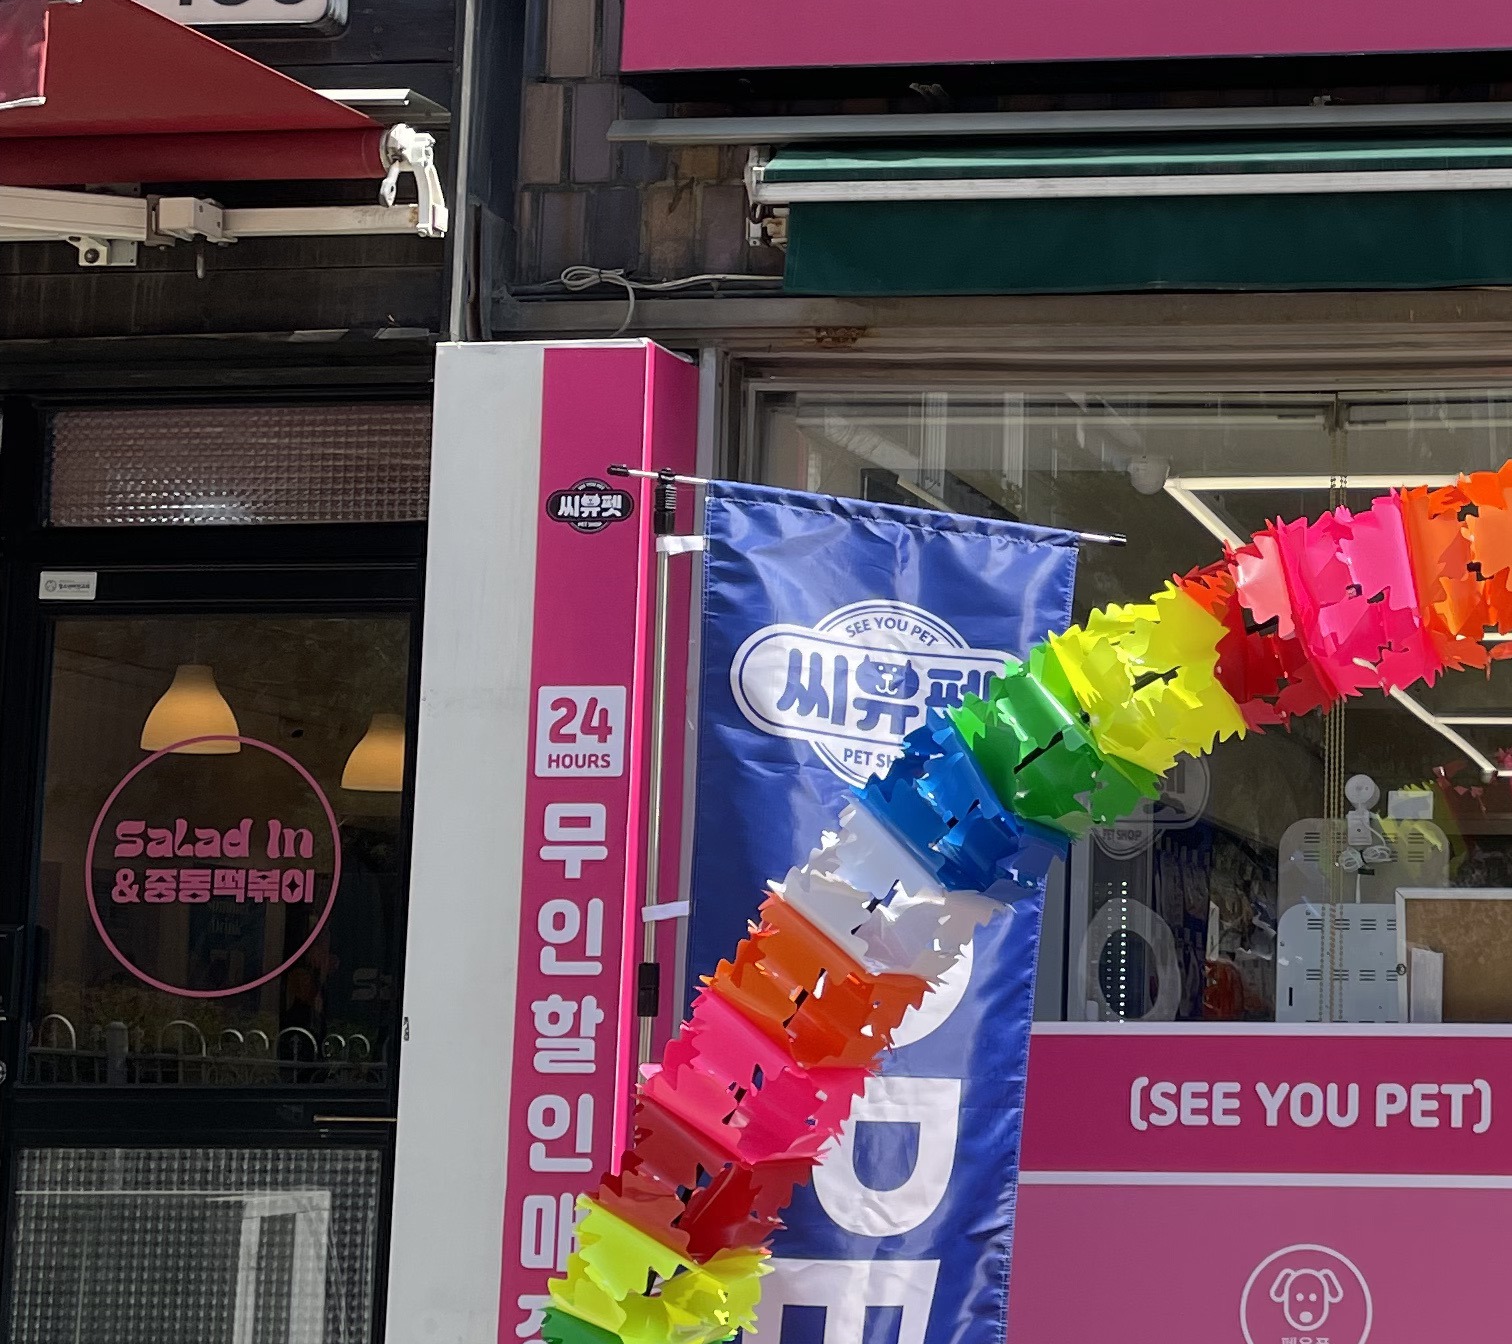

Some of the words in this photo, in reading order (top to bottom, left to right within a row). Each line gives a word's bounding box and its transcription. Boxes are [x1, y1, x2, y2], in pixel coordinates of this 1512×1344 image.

[845, 618, 871, 639] SEE
[873, 616, 909, 632] YOU
[910, 624, 939, 647] PET
[548, 696, 613, 745] 24
[547, 752, 611, 770] HOURS
[843, 747, 873, 766] PET
[876, 753, 897, 769] SH
[114, 818, 255, 859] Salad
[266, 818, 314, 859] In
[1130, 1076, 1241, 1131] (SEE
[1255, 1081, 1360, 1128] YOU
[1374, 1078, 1492, 1134] PET)
